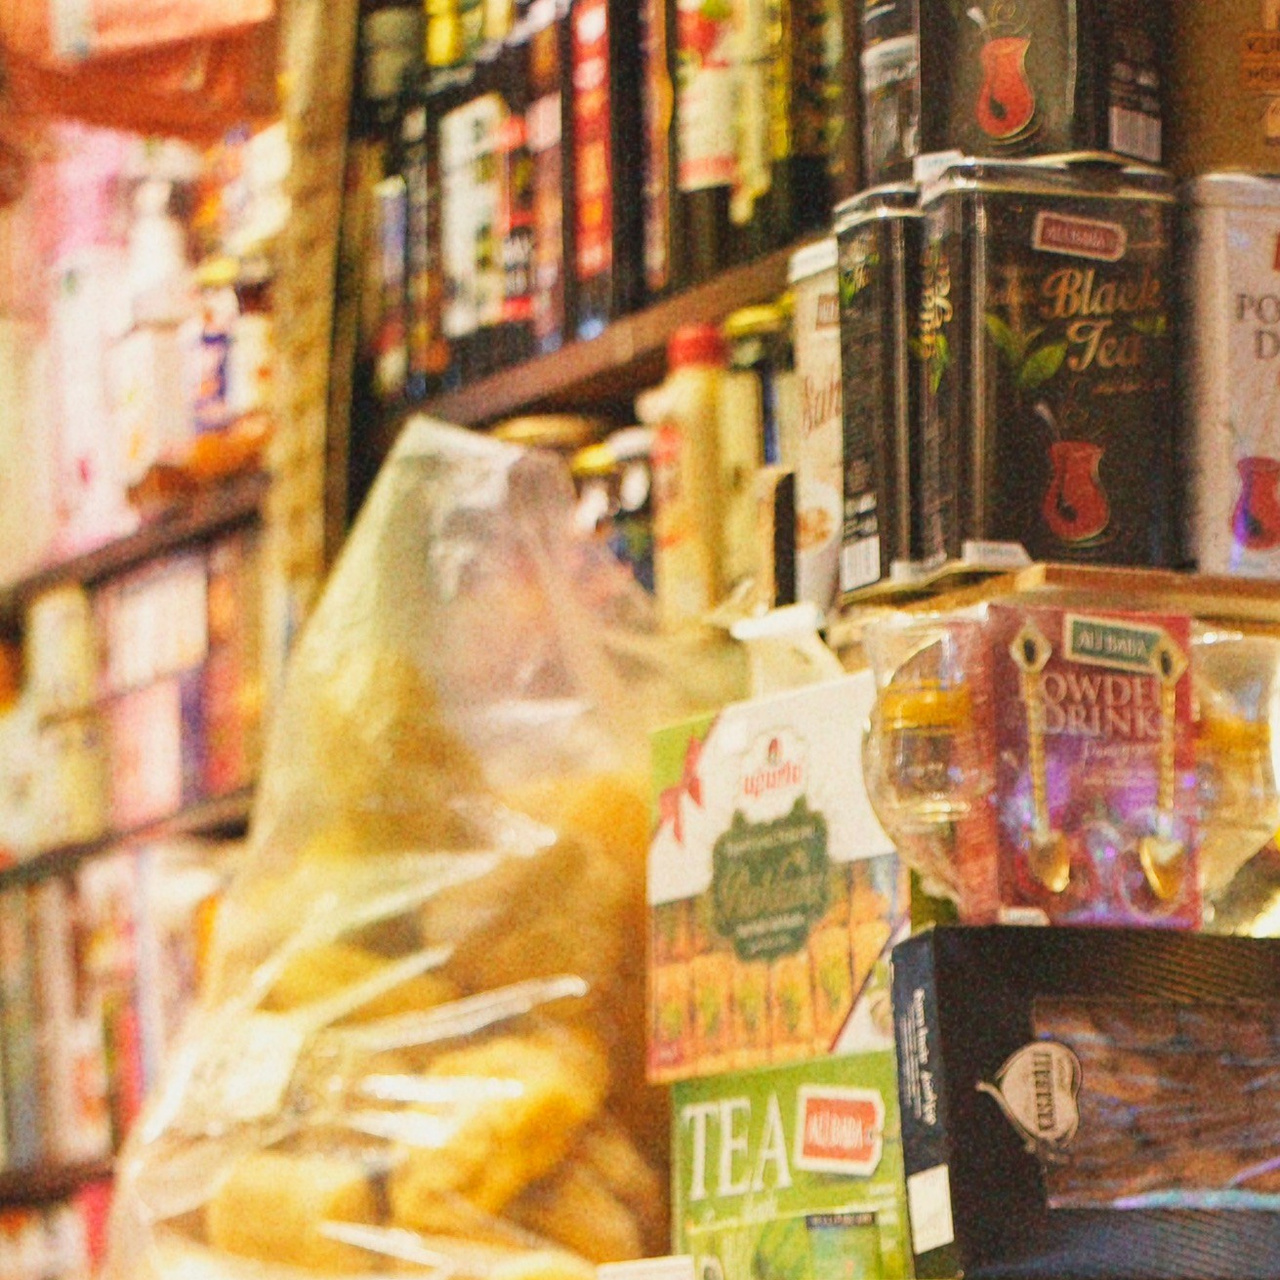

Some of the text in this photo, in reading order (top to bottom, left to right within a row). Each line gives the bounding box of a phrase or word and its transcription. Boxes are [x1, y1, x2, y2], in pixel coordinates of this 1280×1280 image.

[1040, 265, 1164, 320] Black
[1065, 318, 1143, 373] Tea
[680, 1090, 793, 1202] TEA
